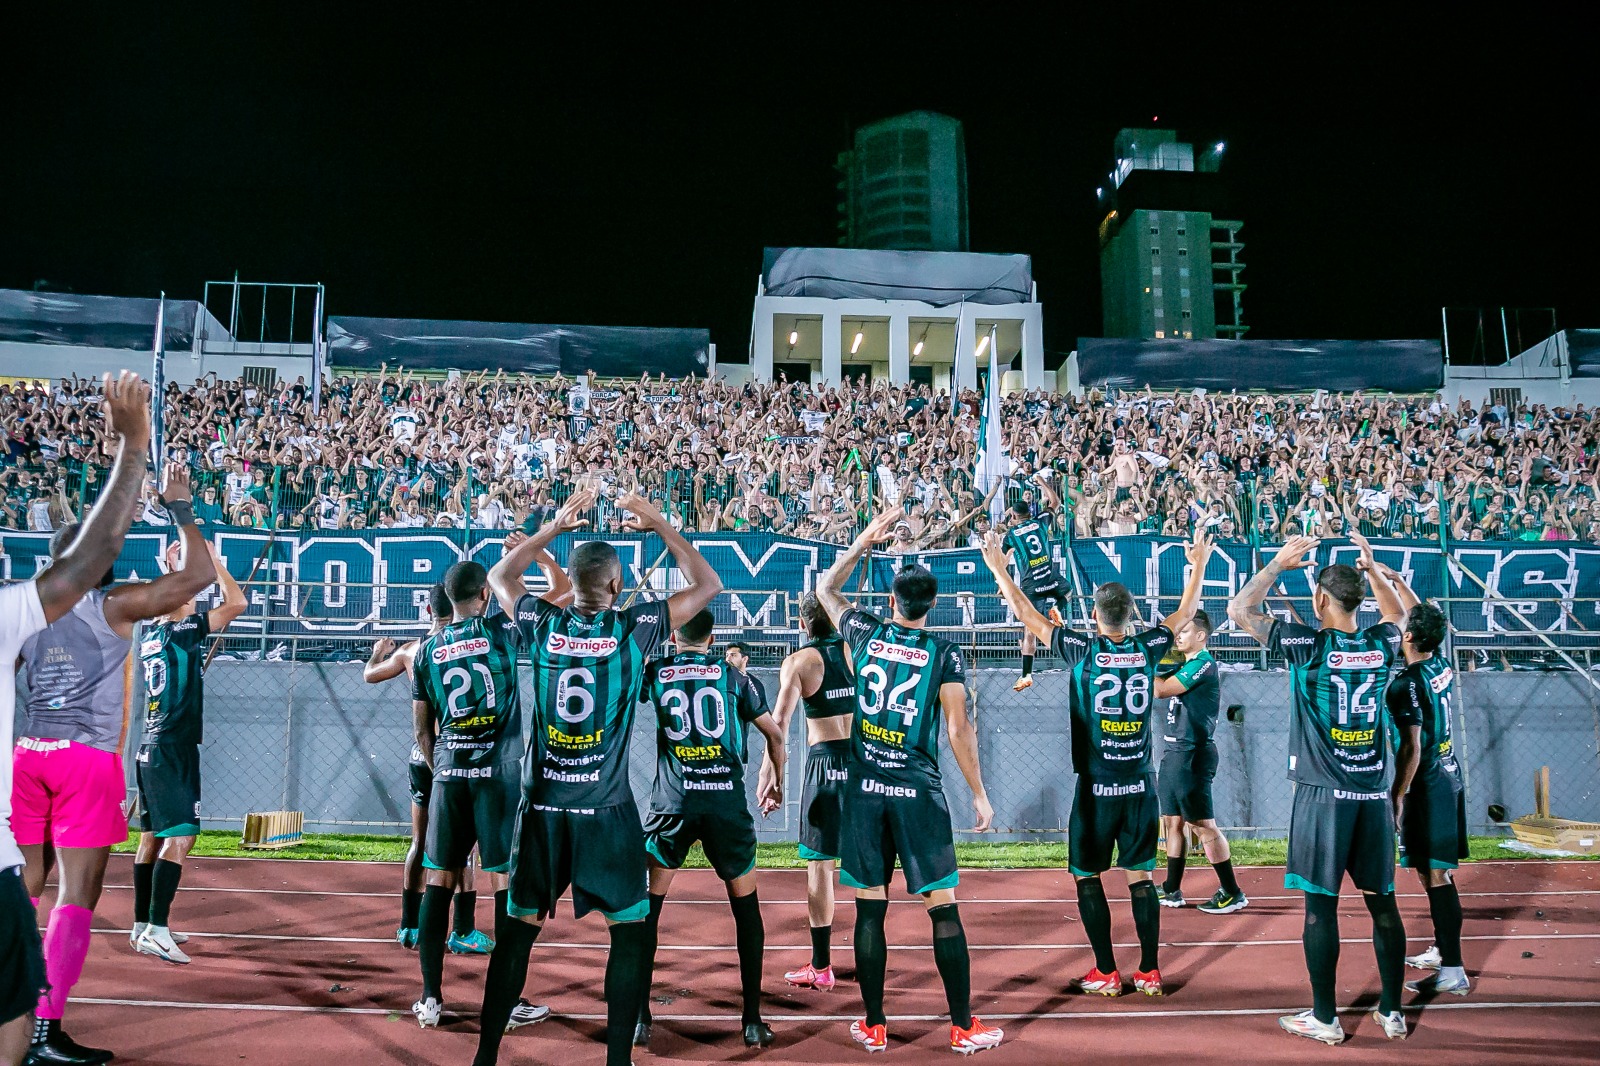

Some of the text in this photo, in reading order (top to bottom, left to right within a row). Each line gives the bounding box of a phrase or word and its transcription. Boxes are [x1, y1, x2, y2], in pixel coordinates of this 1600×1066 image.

[1026, 535, 1042, 555] 3
[450, 639, 488, 654] amigão
[568, 637, 617, 653] amigão
[886, 646, 928, 662] amigão
[1114, 654, 1146, 665] amigão
[1345, 652, 1384, 665] amigão
[678, 666, 720, 679] amigão
[442, 662, 496, 718] 21
[556, 667, 595, 724] 6
[858, 663, 923, 727] 34
[1093, 673, 1150, 715] 28
[1330, 673, 1377, 725] 14
[659, 686, 726, 741] 30
[1100, 719, 1143, 733] REVEST
[1330, 727, 1376, 742] REVEST
[543, 767, 600, 783] Unimed
[826, 768, 848, 781] Uni
[683, 779, 734, 791] Unimed
[1092, 780, 1146, 797] Unimed
